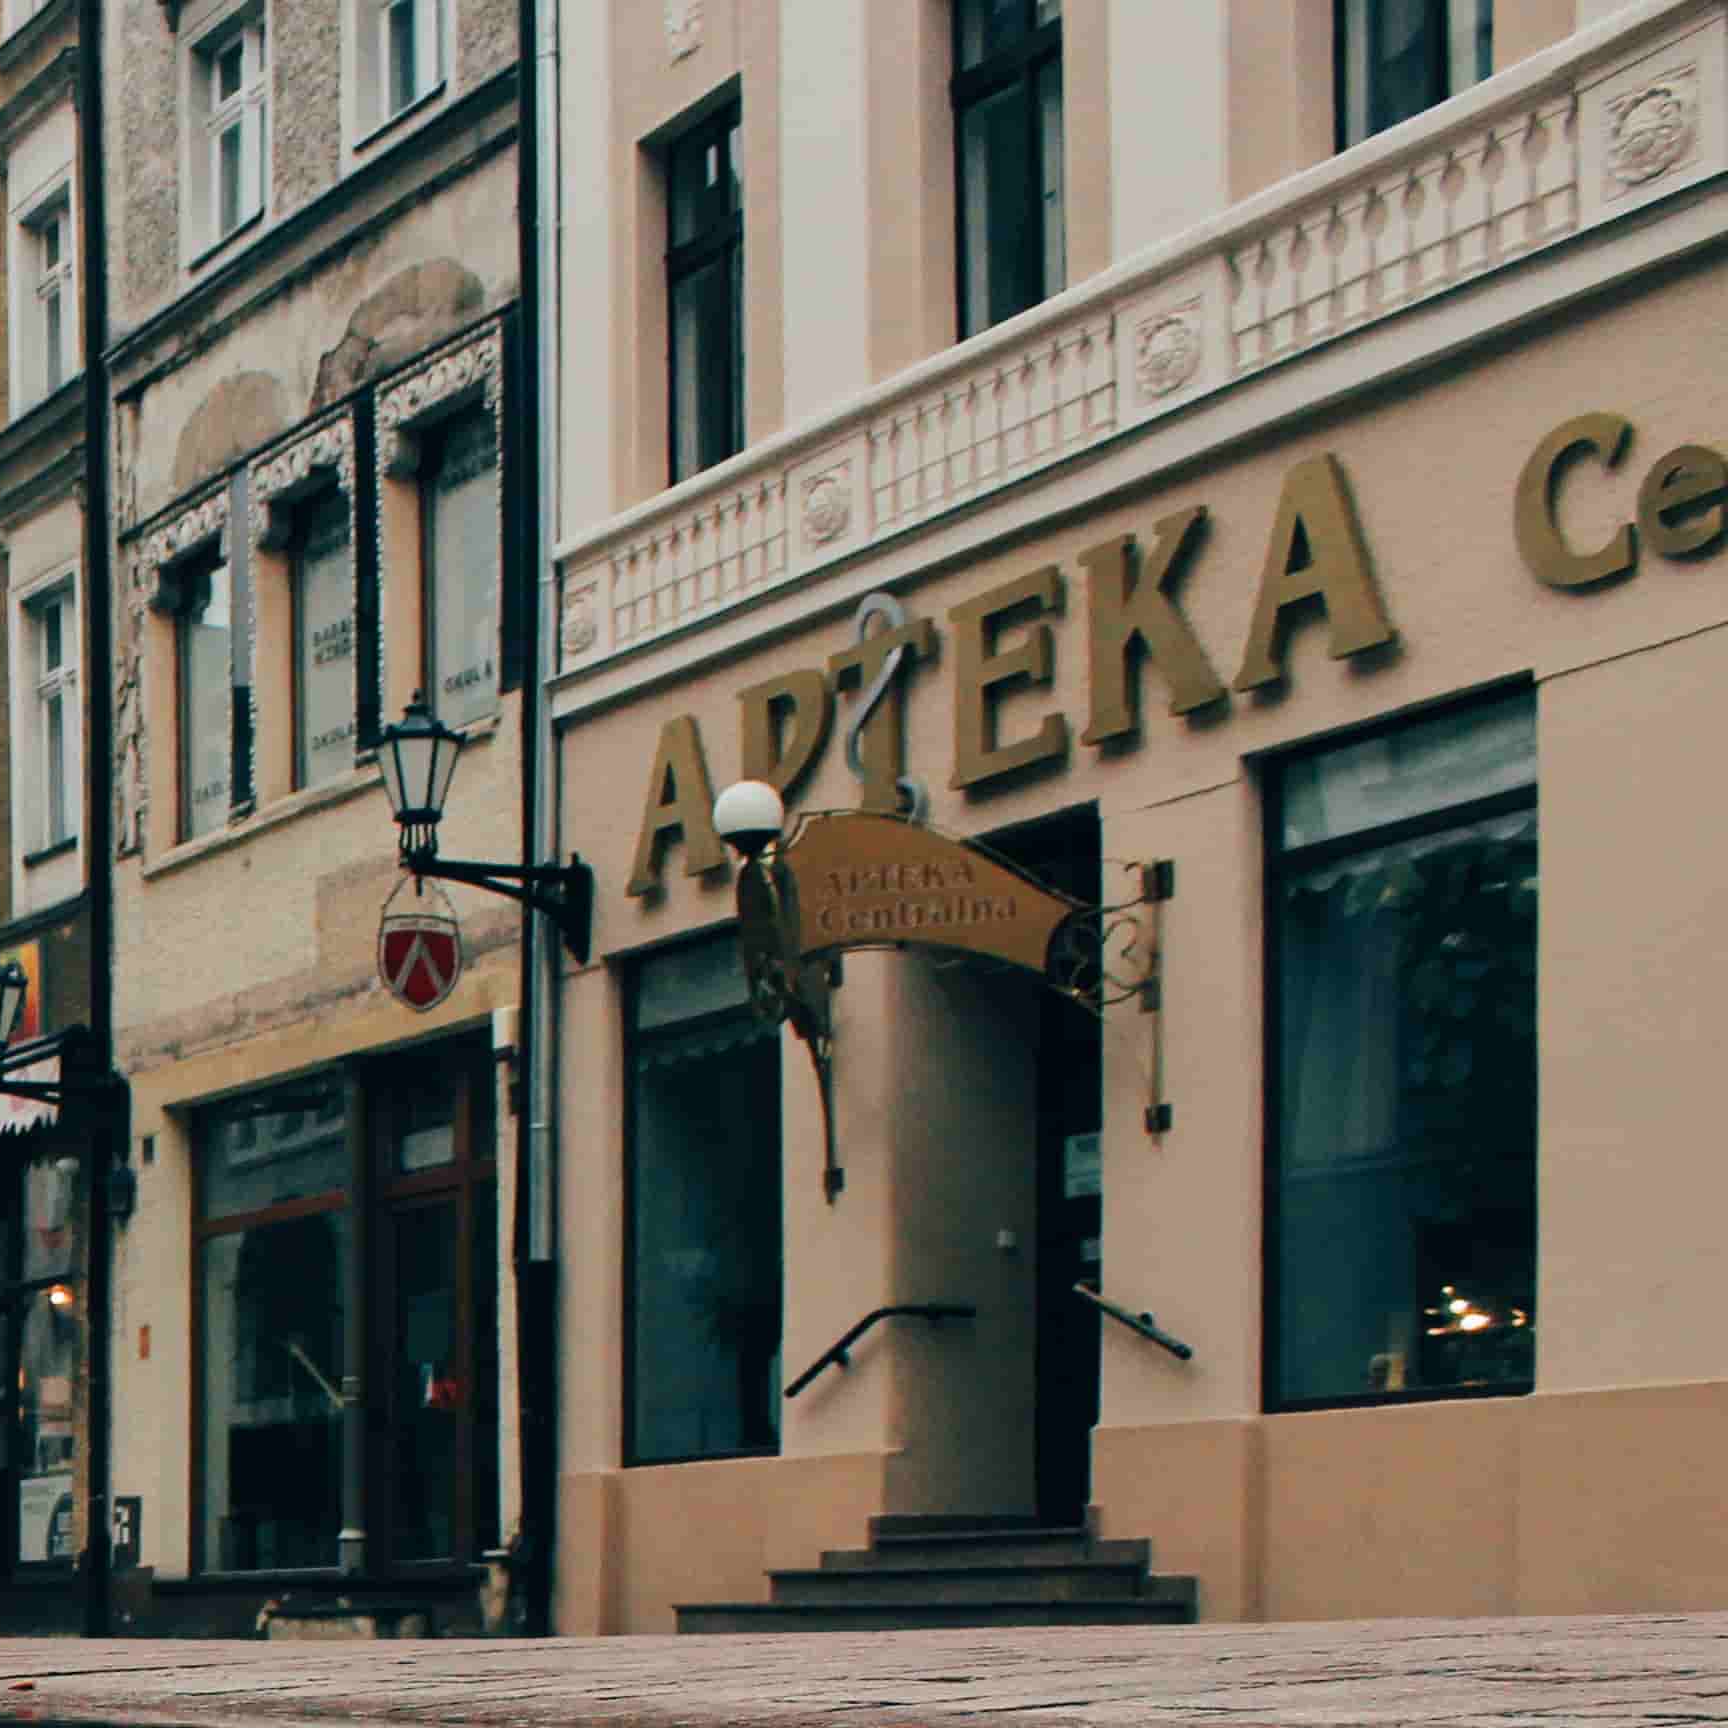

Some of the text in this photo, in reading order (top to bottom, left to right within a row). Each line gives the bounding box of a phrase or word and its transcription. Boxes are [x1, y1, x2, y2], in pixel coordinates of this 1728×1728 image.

[625, 452, 1400, 898] APTEKA
[820, 862, 977, 897] APTEKA
[817, 896, 1018, 933] Centralna
